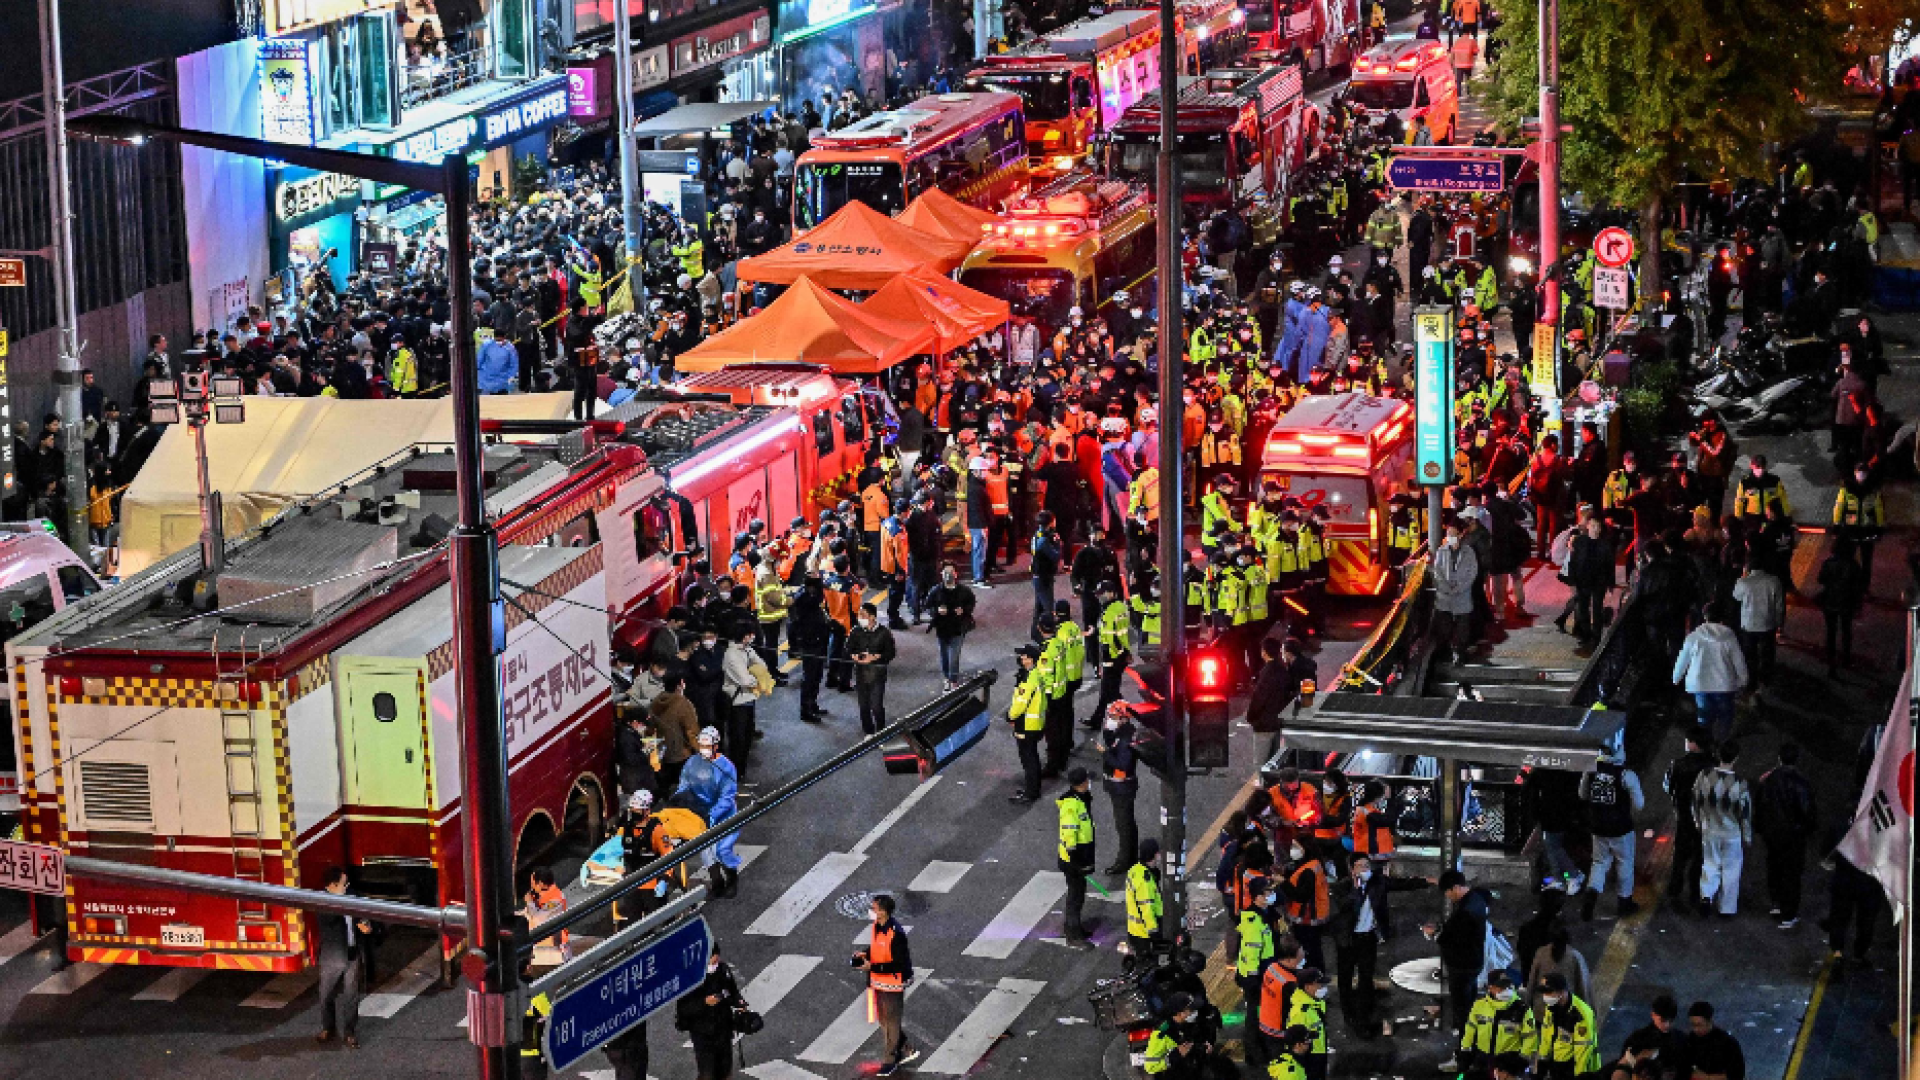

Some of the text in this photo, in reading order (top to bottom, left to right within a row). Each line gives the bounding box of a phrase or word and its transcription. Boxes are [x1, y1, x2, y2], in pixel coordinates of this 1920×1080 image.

[522, 89, 568, 127] COFFEE
[0, 847, 59, 889] 좌회전
[682, 939, 703, 969] 177
[600, 953, 658, 1005] 이태원로
[554, 1015, 576, 1047] 181
